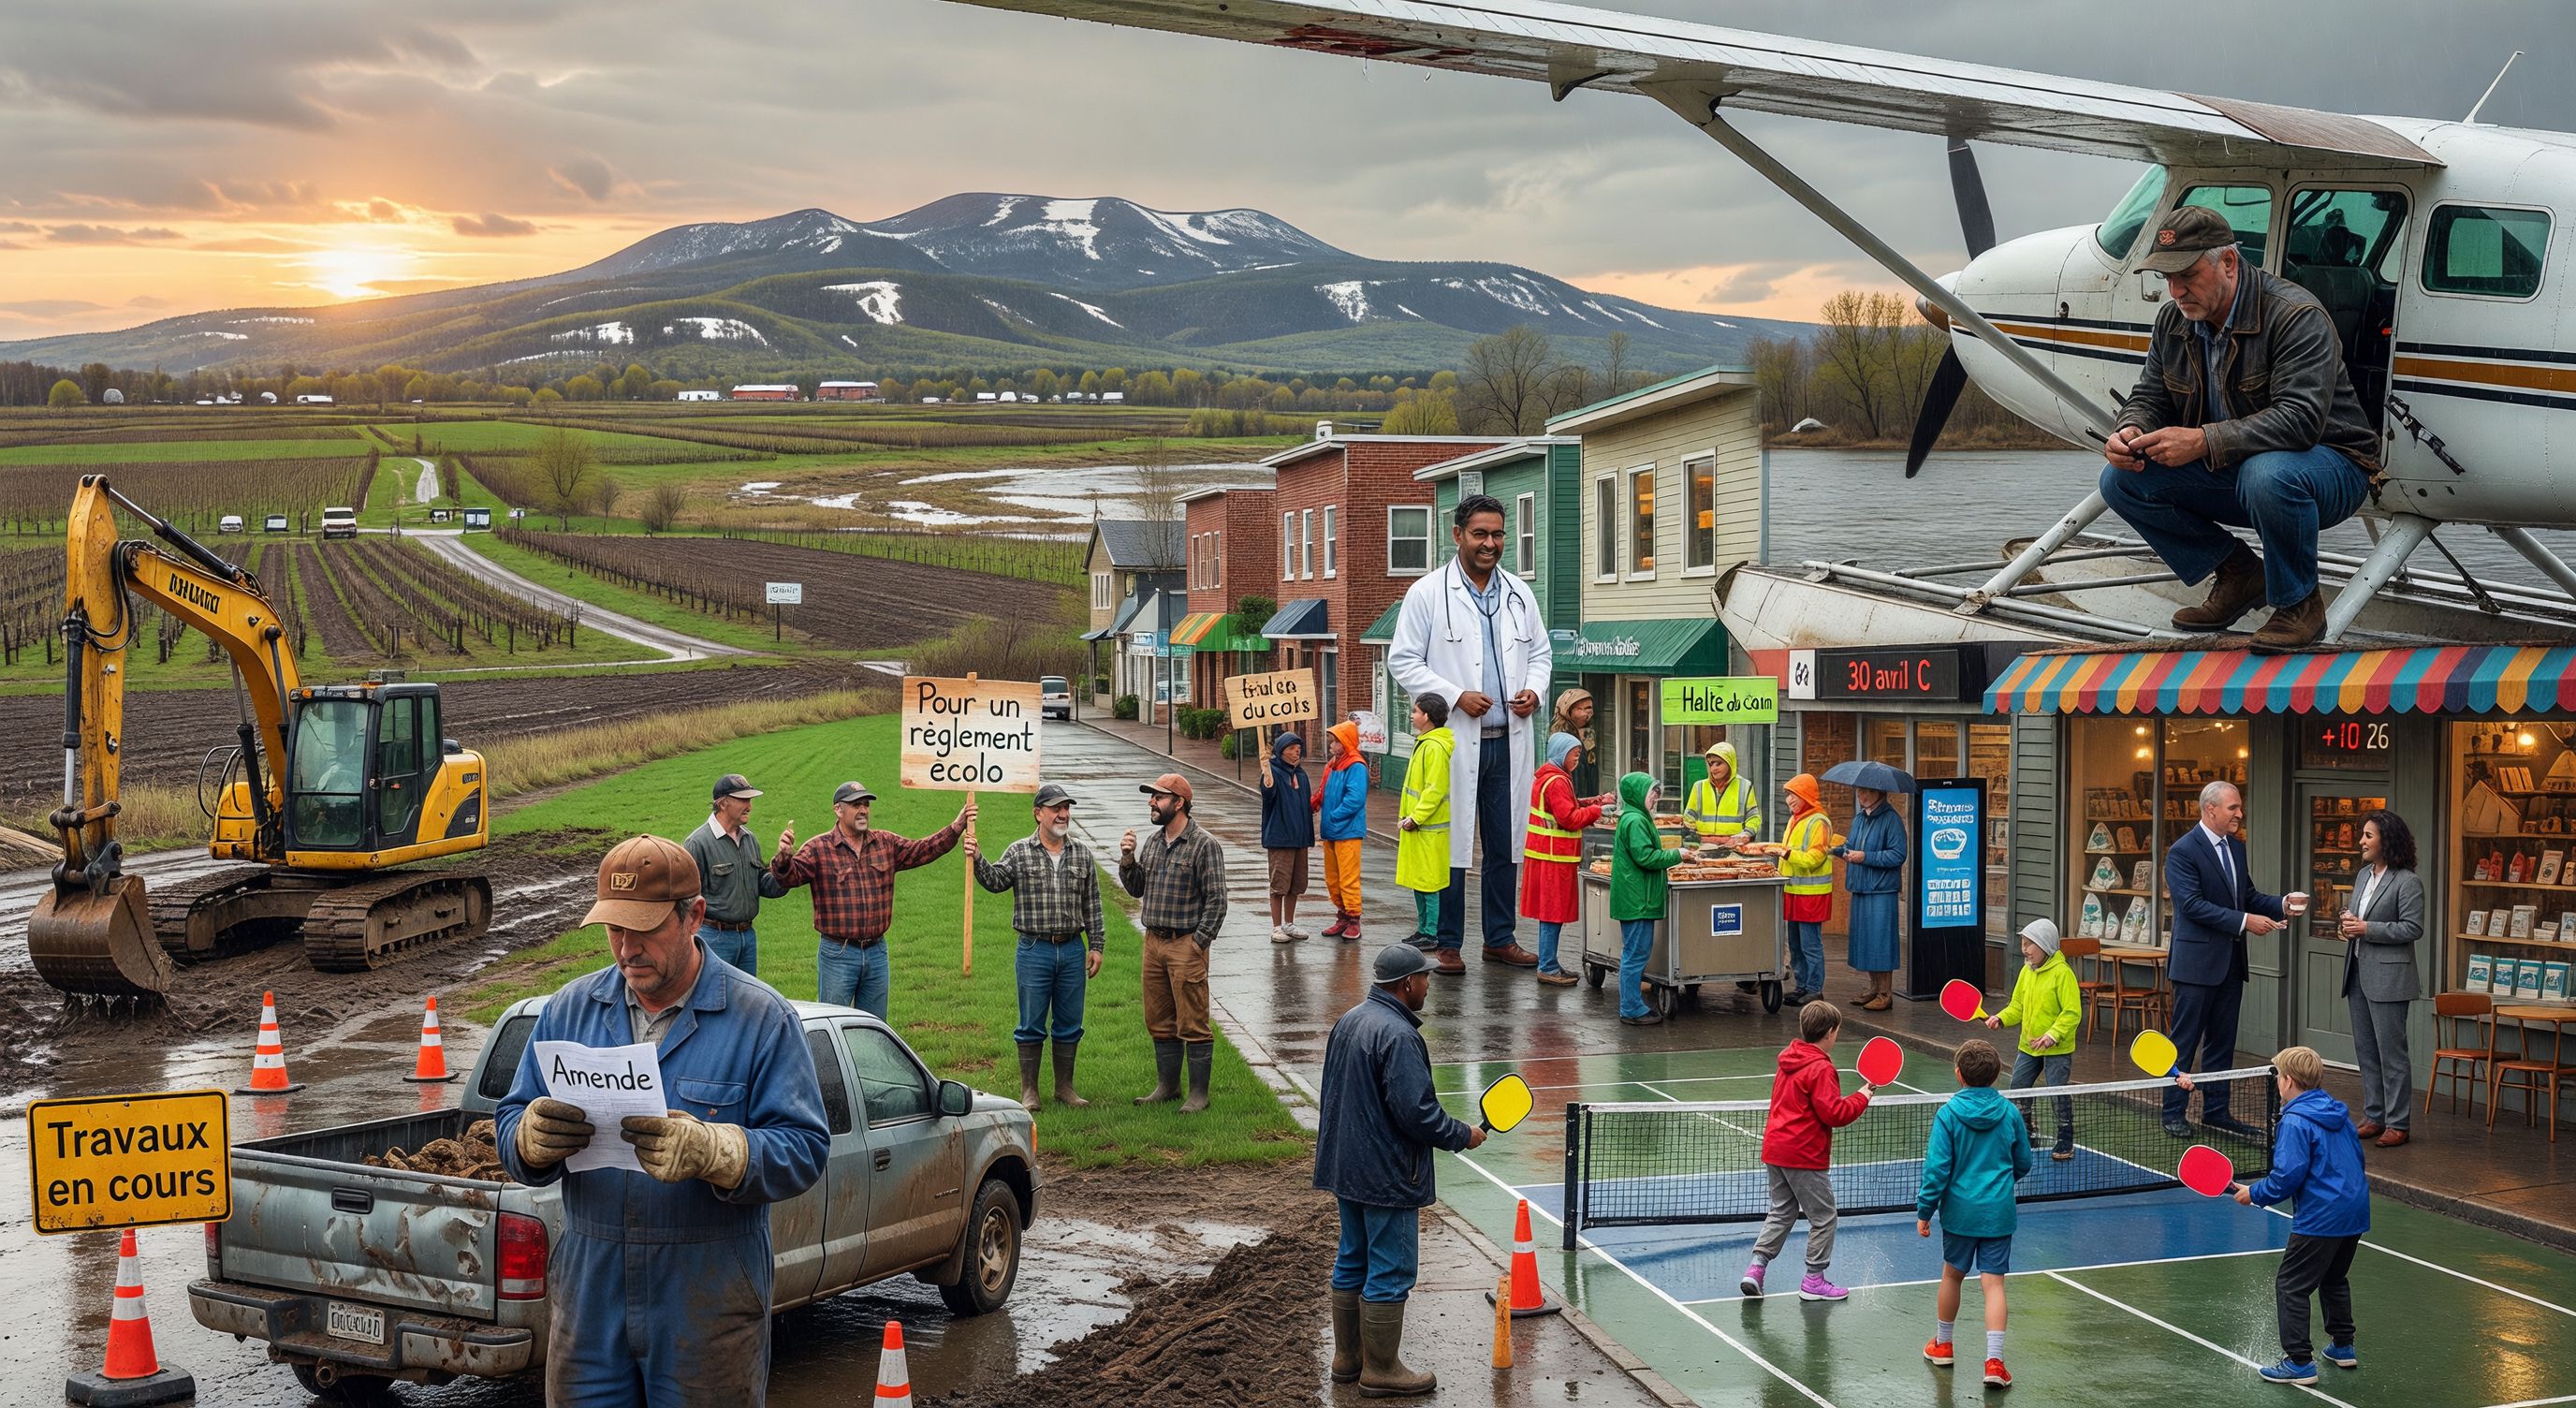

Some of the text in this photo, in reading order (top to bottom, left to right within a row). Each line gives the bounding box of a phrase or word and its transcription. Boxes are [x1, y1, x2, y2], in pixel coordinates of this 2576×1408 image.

[1847, 659, 1931, 692] 30 avril C
[917, 682, 1020, 718] Pour un
[1243, 702, 1265, 720] du
[1683, 686, 1723, 712] Halte
[2322, 722, 2389, 750] +10 26
[552, 1054, 653, 1091] Amende
[47, 1121, 209, 1159] Travaux
[48, 1169, 215, 1206] en cours
